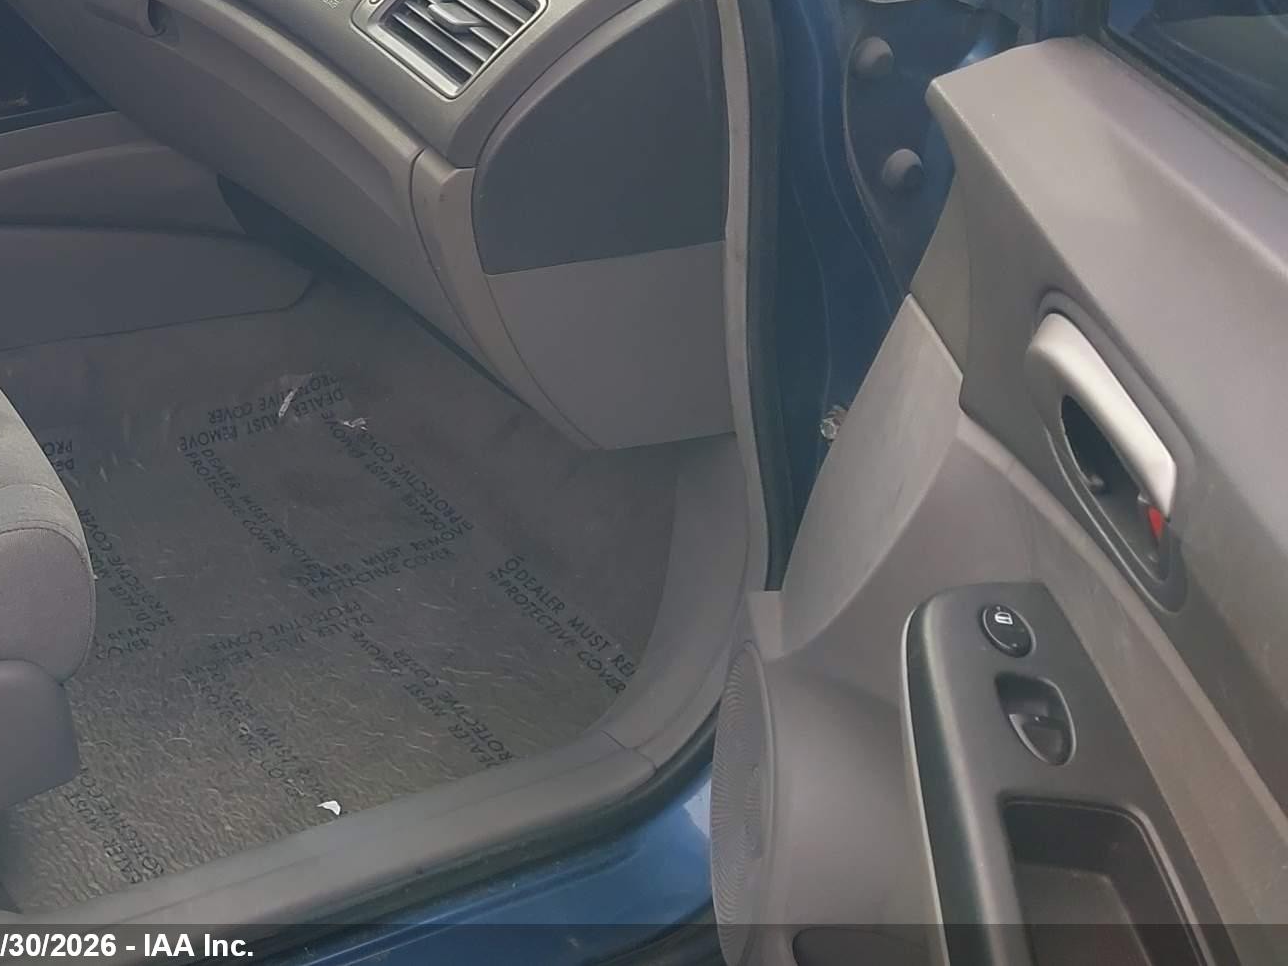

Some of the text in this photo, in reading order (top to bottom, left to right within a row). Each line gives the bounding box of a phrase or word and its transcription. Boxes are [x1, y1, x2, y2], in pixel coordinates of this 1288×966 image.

[208, 401, 253, 424] COVER
[293, 387, 345, 419] DEALER
[179, 428, 238, 452] REMOVE
[202, 448, 241, 489] DEALER
[185, 452, 281, 554] PROTECTIVE COVER
[392, 465, 465, 524] PROTECTIVE
[514, 569, 566, 614] DEALER
[568, 616, 612, 651] MUST
[498, 579, 626, 694] PROTECTIVE COVER
